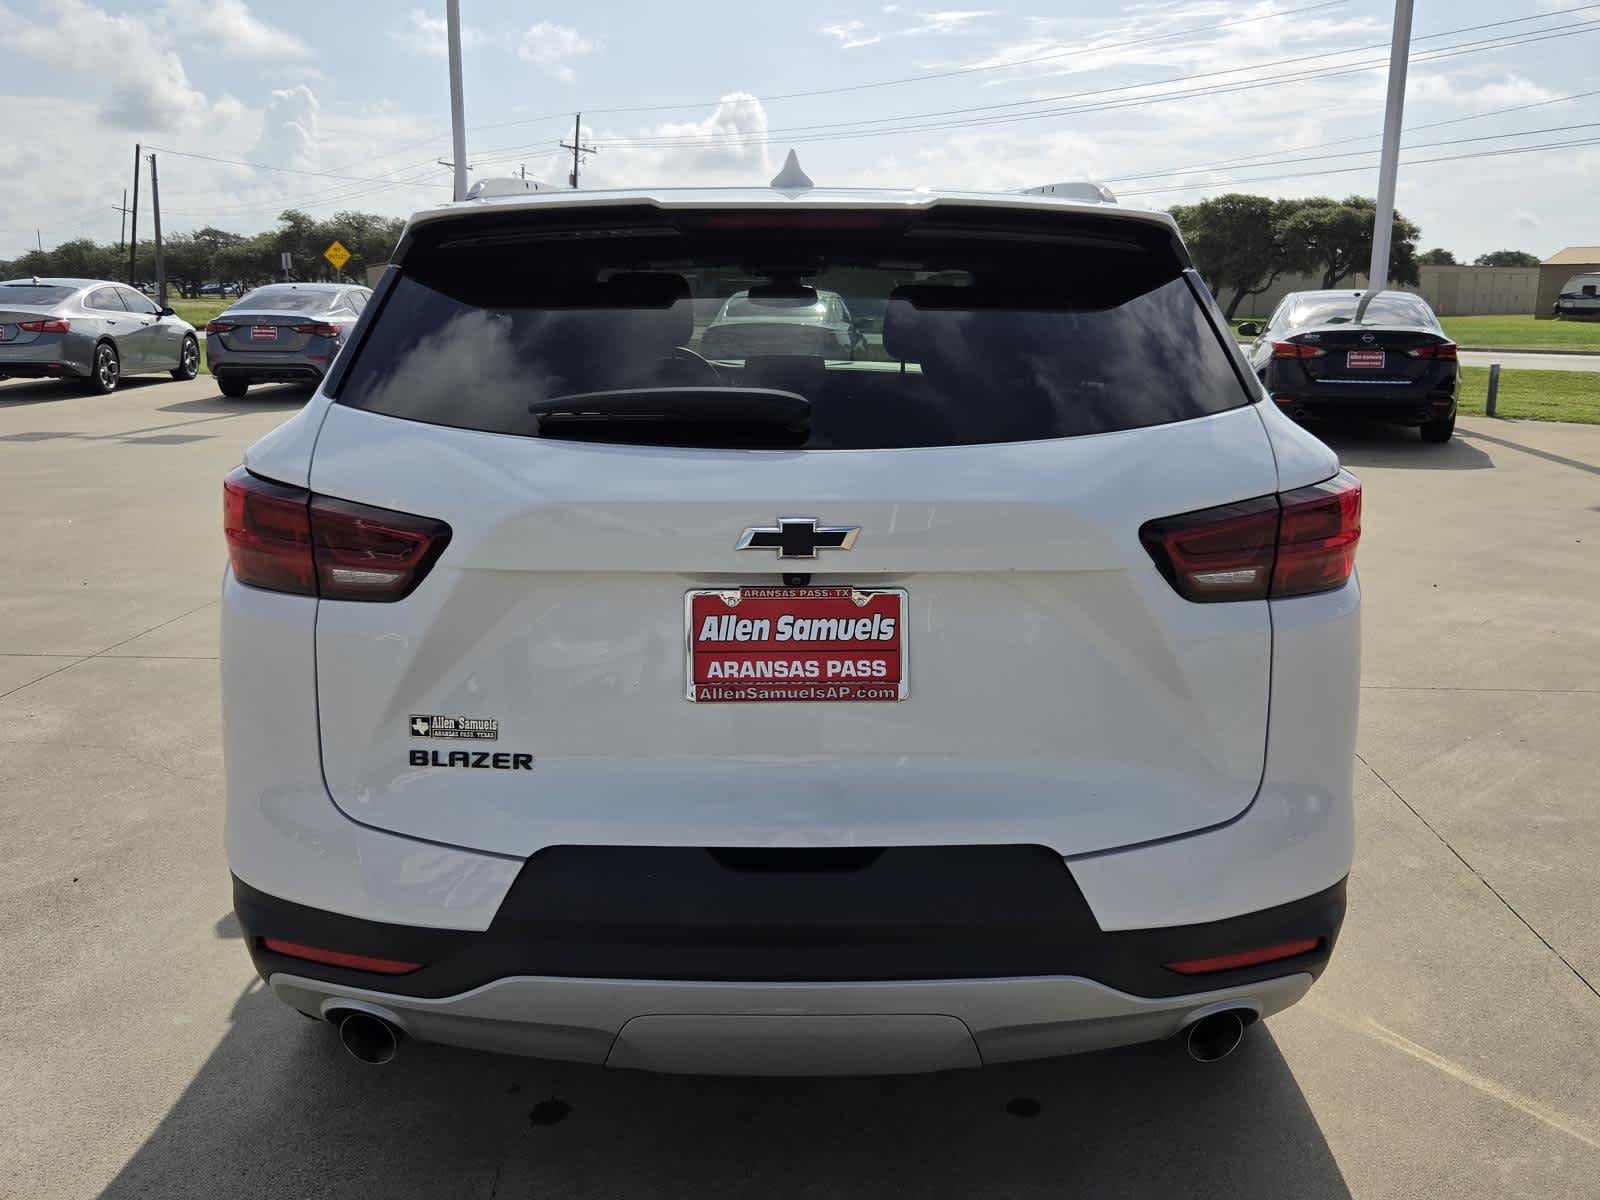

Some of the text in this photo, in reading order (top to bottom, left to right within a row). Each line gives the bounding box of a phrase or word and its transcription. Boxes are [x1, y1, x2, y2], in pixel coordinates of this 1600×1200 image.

[743, 589, 796, 598] ARANSAS
[835, 589, 850, 598] TX
[699, 614, 896, 641] Allen Samuels
[707, 660, 887, 678] ARANSAS PASS
[700, 687, 895, 700] AllenSamuelsAP.com
[432, 716, 497, 731] Allen Samuels
[409, 749, 533, 771] BLAZER
